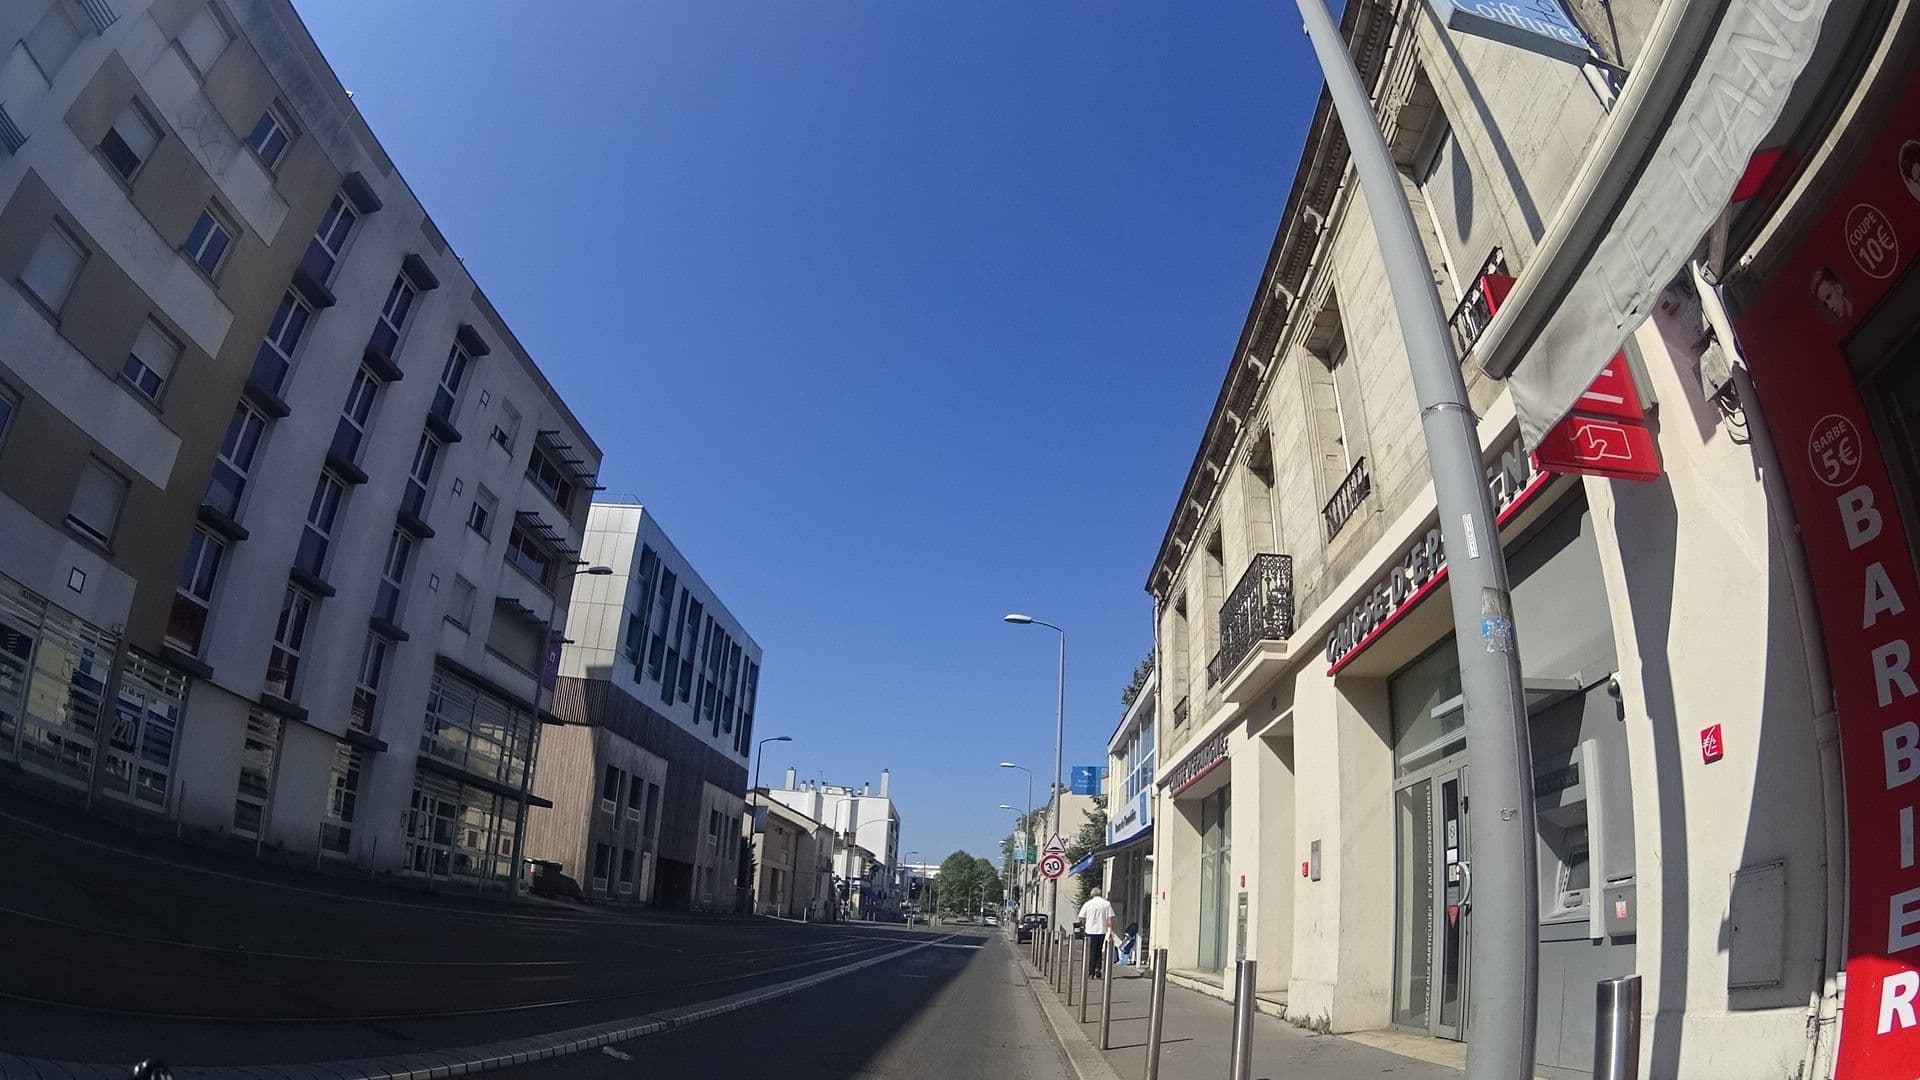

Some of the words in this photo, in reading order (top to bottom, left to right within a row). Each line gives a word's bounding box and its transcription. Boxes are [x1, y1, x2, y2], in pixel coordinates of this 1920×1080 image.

[1849, 211, 1877, 246] COUPE
[1859, 225, 1895, 271] 10€
[1596, 201, 1671, 329] LE
[1812, 420, 1848, 453] BARBE
[1821, 436, 1858, 481] 5€
[1326, 583, 1385, 663] CAISSE
[1837, 484, 1920, 1035] BARBIER
[1045, 860, 1060, 873] 30
